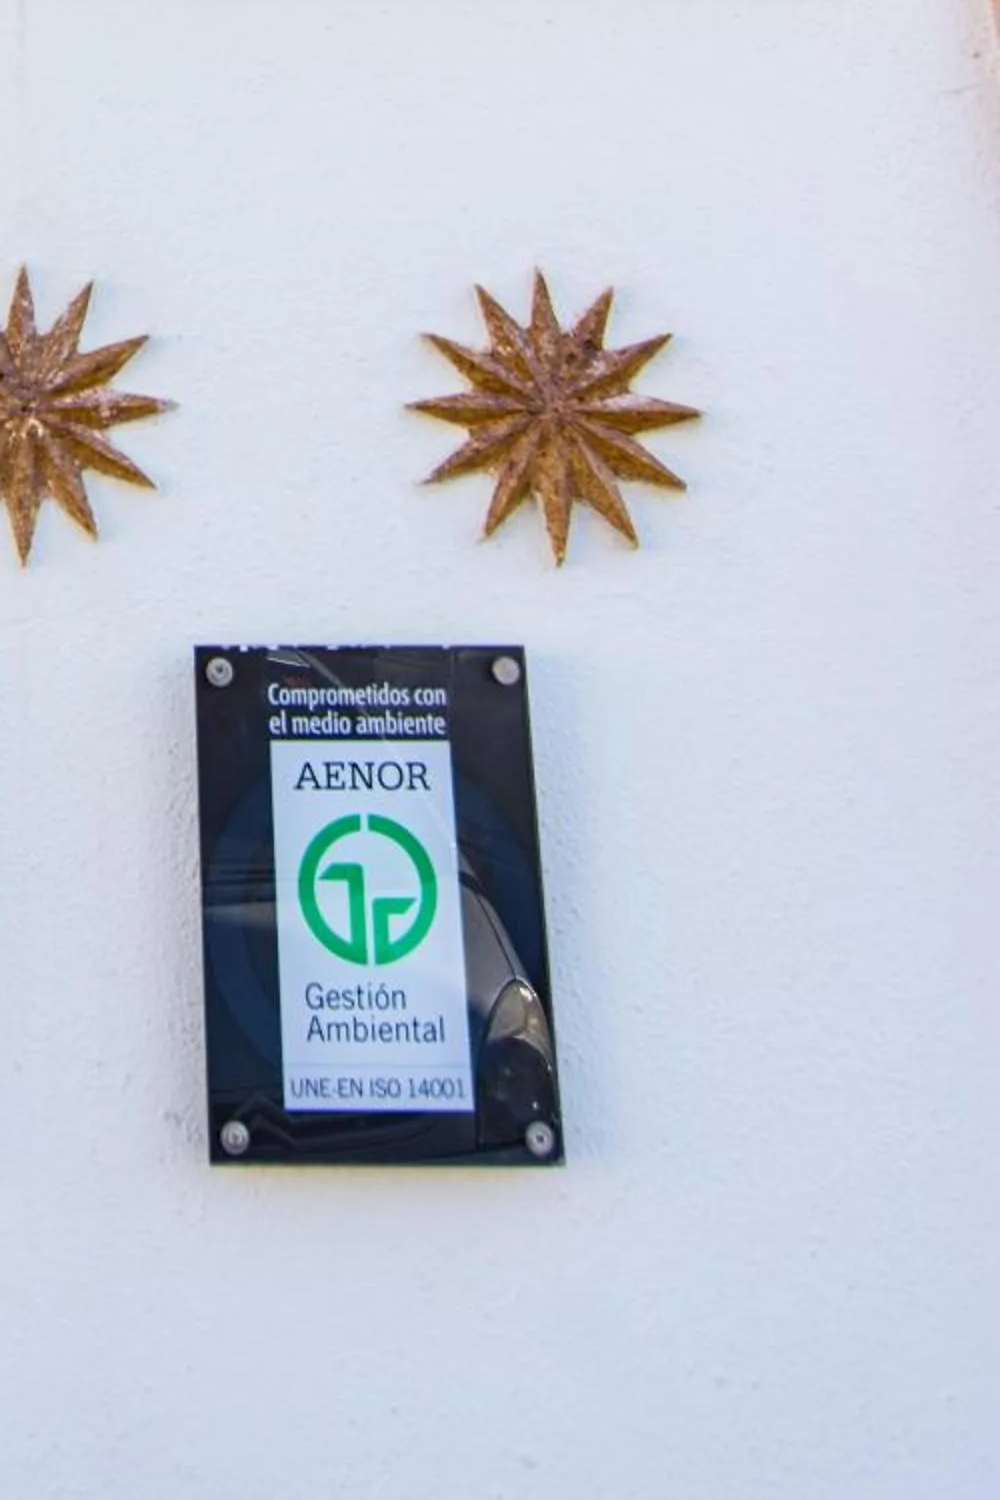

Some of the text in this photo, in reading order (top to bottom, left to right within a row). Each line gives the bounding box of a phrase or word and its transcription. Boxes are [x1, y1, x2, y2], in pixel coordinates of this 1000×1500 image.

[268, 682, 447, 711] Comprometidos con
[269, 710, 447, 736] el medio ambiente
[293, 760, 431, 791] AENOR
[305, 981, 408, 1011] Gestión
[306, 1014, 446, 1043] Ambiental
[290, 1077, 466, 1100] UNE-EN ISO 14001
